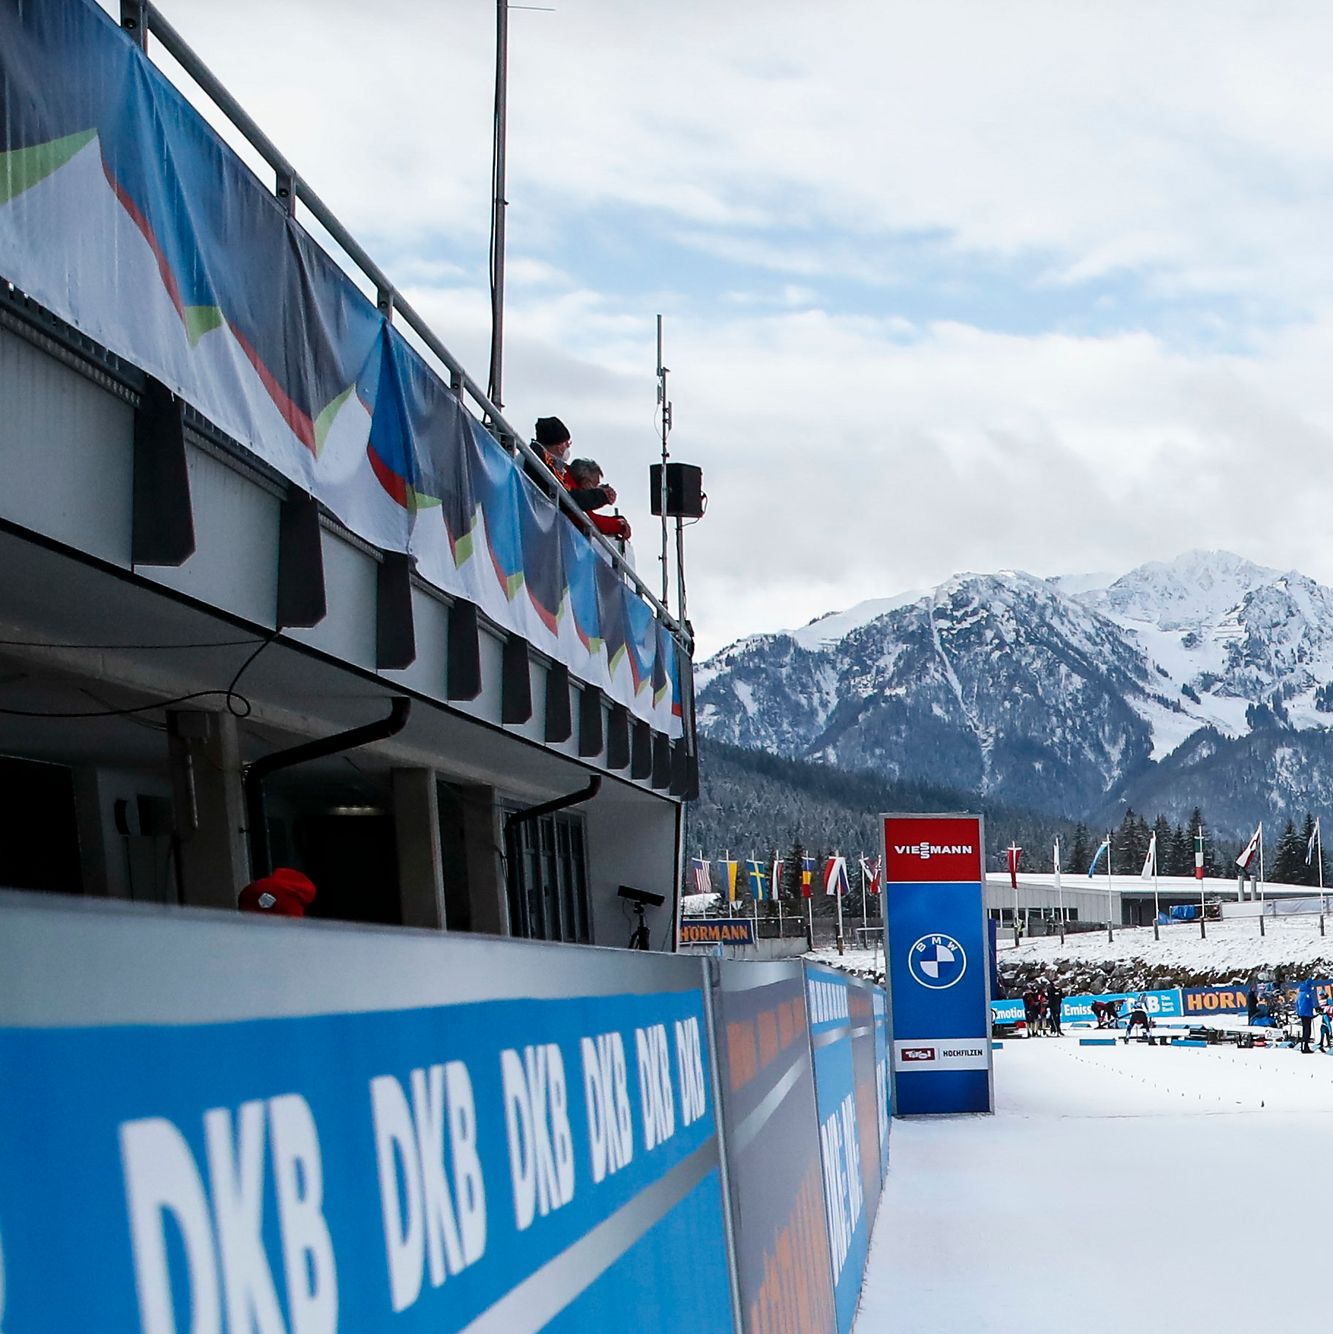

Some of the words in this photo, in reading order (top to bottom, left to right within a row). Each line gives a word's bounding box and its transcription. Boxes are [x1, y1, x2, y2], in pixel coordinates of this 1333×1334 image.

[894, 842, 972, 859] VIESSMANN
[680, 924, 748, 941] HÖRMANN
[916, 937, 958, 952] BMW
[370, 1060, 486, 1313] DKB
[500, 1044, 574, 1231] DKB
[580, 1032, 633, 1183] DKB
[635, 1023, 675, 1150] DKB
